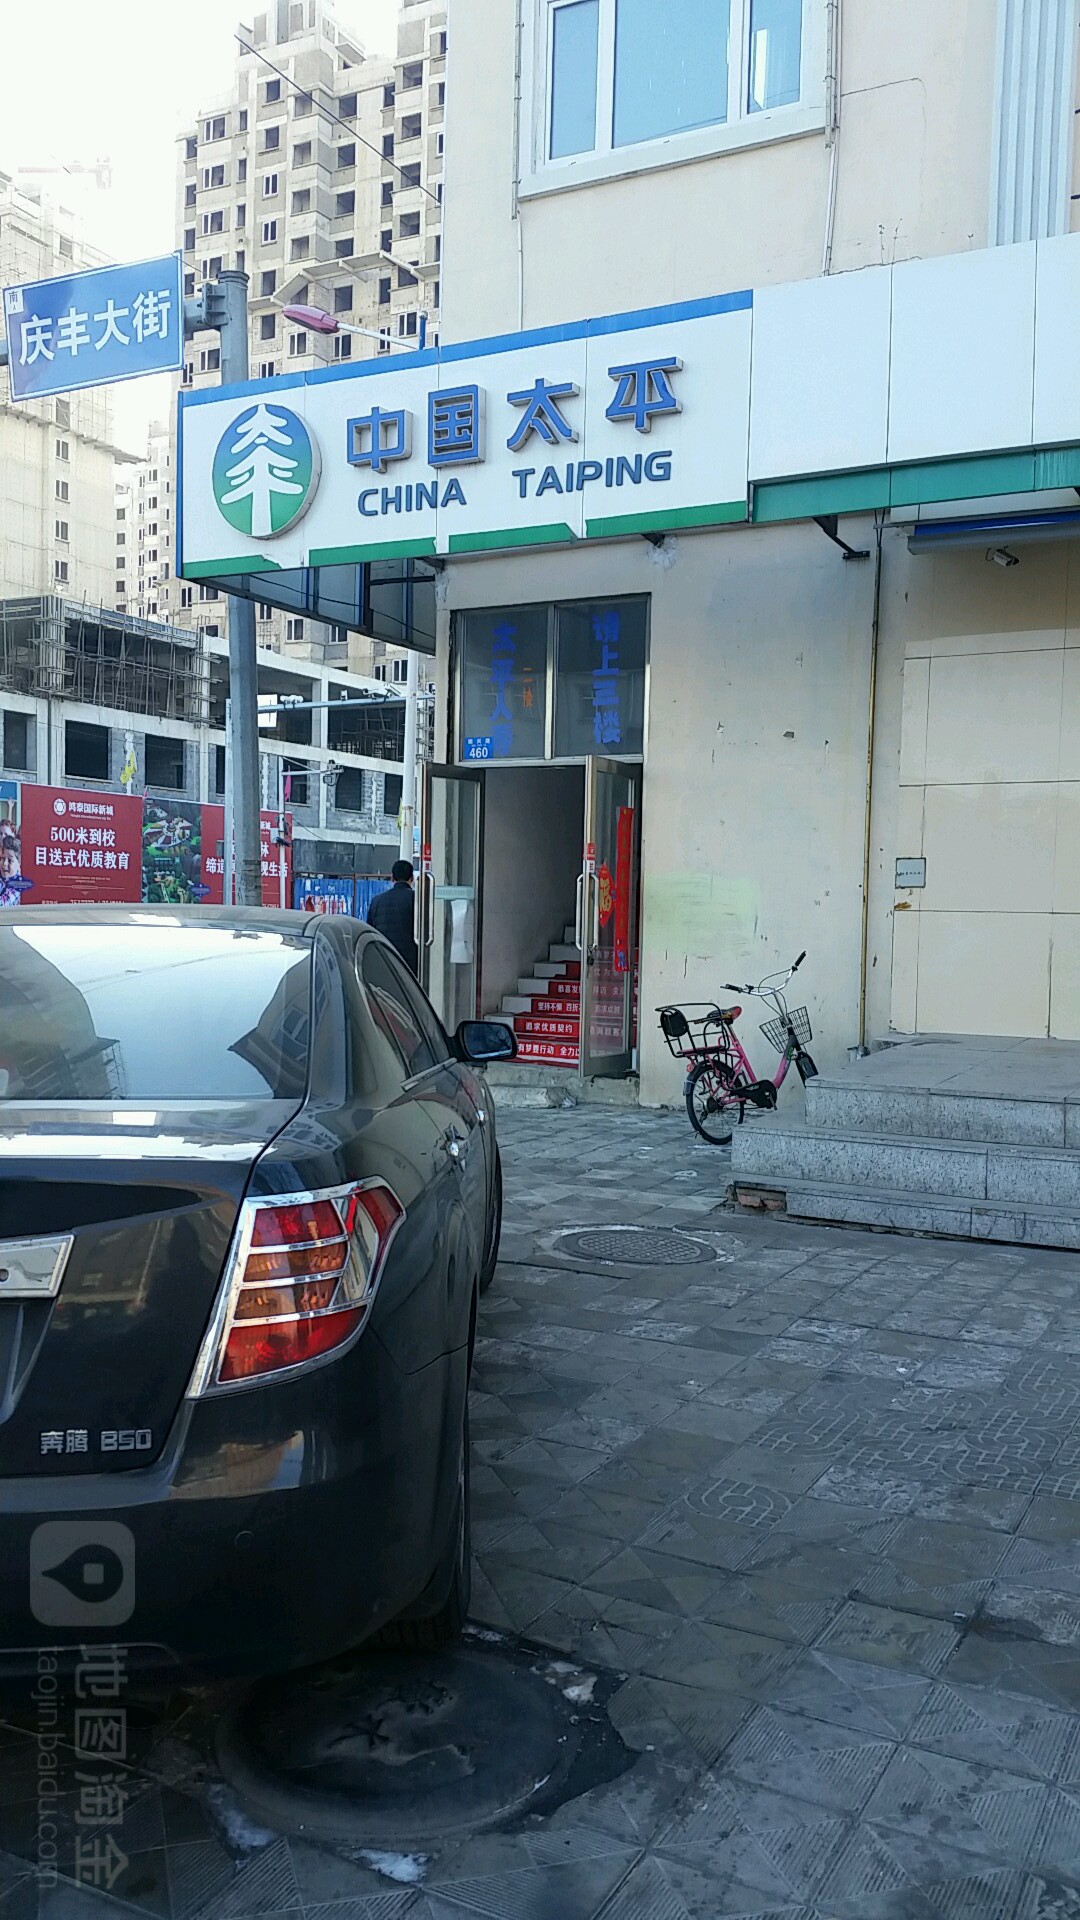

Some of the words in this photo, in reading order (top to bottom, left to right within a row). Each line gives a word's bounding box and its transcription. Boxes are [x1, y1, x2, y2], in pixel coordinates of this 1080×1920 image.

[9, 291, 18, 303] 南
[19, 289, 171, 366] 庆丰大街
[346, 356, 683, 474] 中国太平
[357, 478, 467, 517] CHINA
[511, 450, 673, 498] TAIPING
[469, 746, 489, 759] 460
[50, 826, 116, 847] 500米到校
[35, 846, 131, 870] 目送式优质教育
[558, 984, 580, 994] 恭喜发
[566, 1003, 580, 1012] 百折
[526, 1022, 573, 1034] 追求优质契约
[41, 1429, 88, 1454] 奔腾
[101, 1429, 152, 1451] B50
